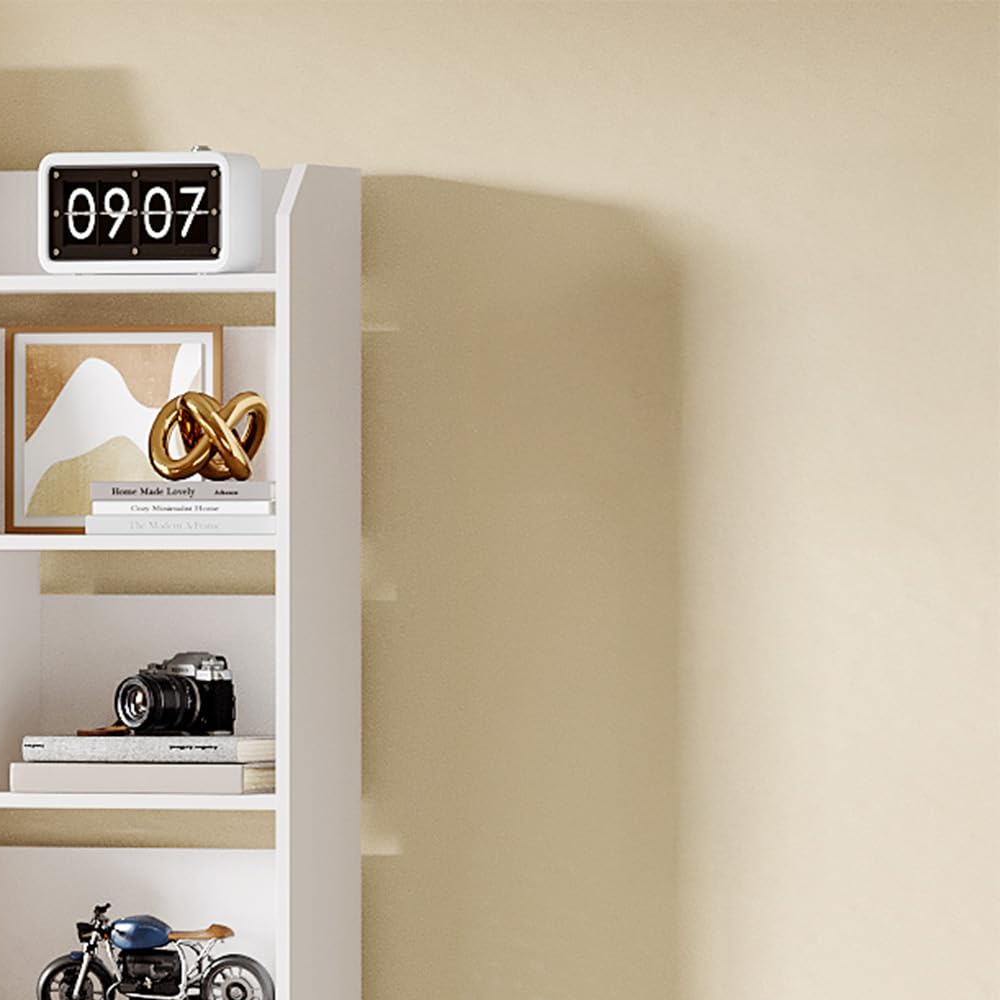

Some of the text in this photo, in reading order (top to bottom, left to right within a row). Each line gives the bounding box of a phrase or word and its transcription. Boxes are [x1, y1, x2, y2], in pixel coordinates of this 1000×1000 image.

[112, 487, 195, 498] Home Made Lovely
